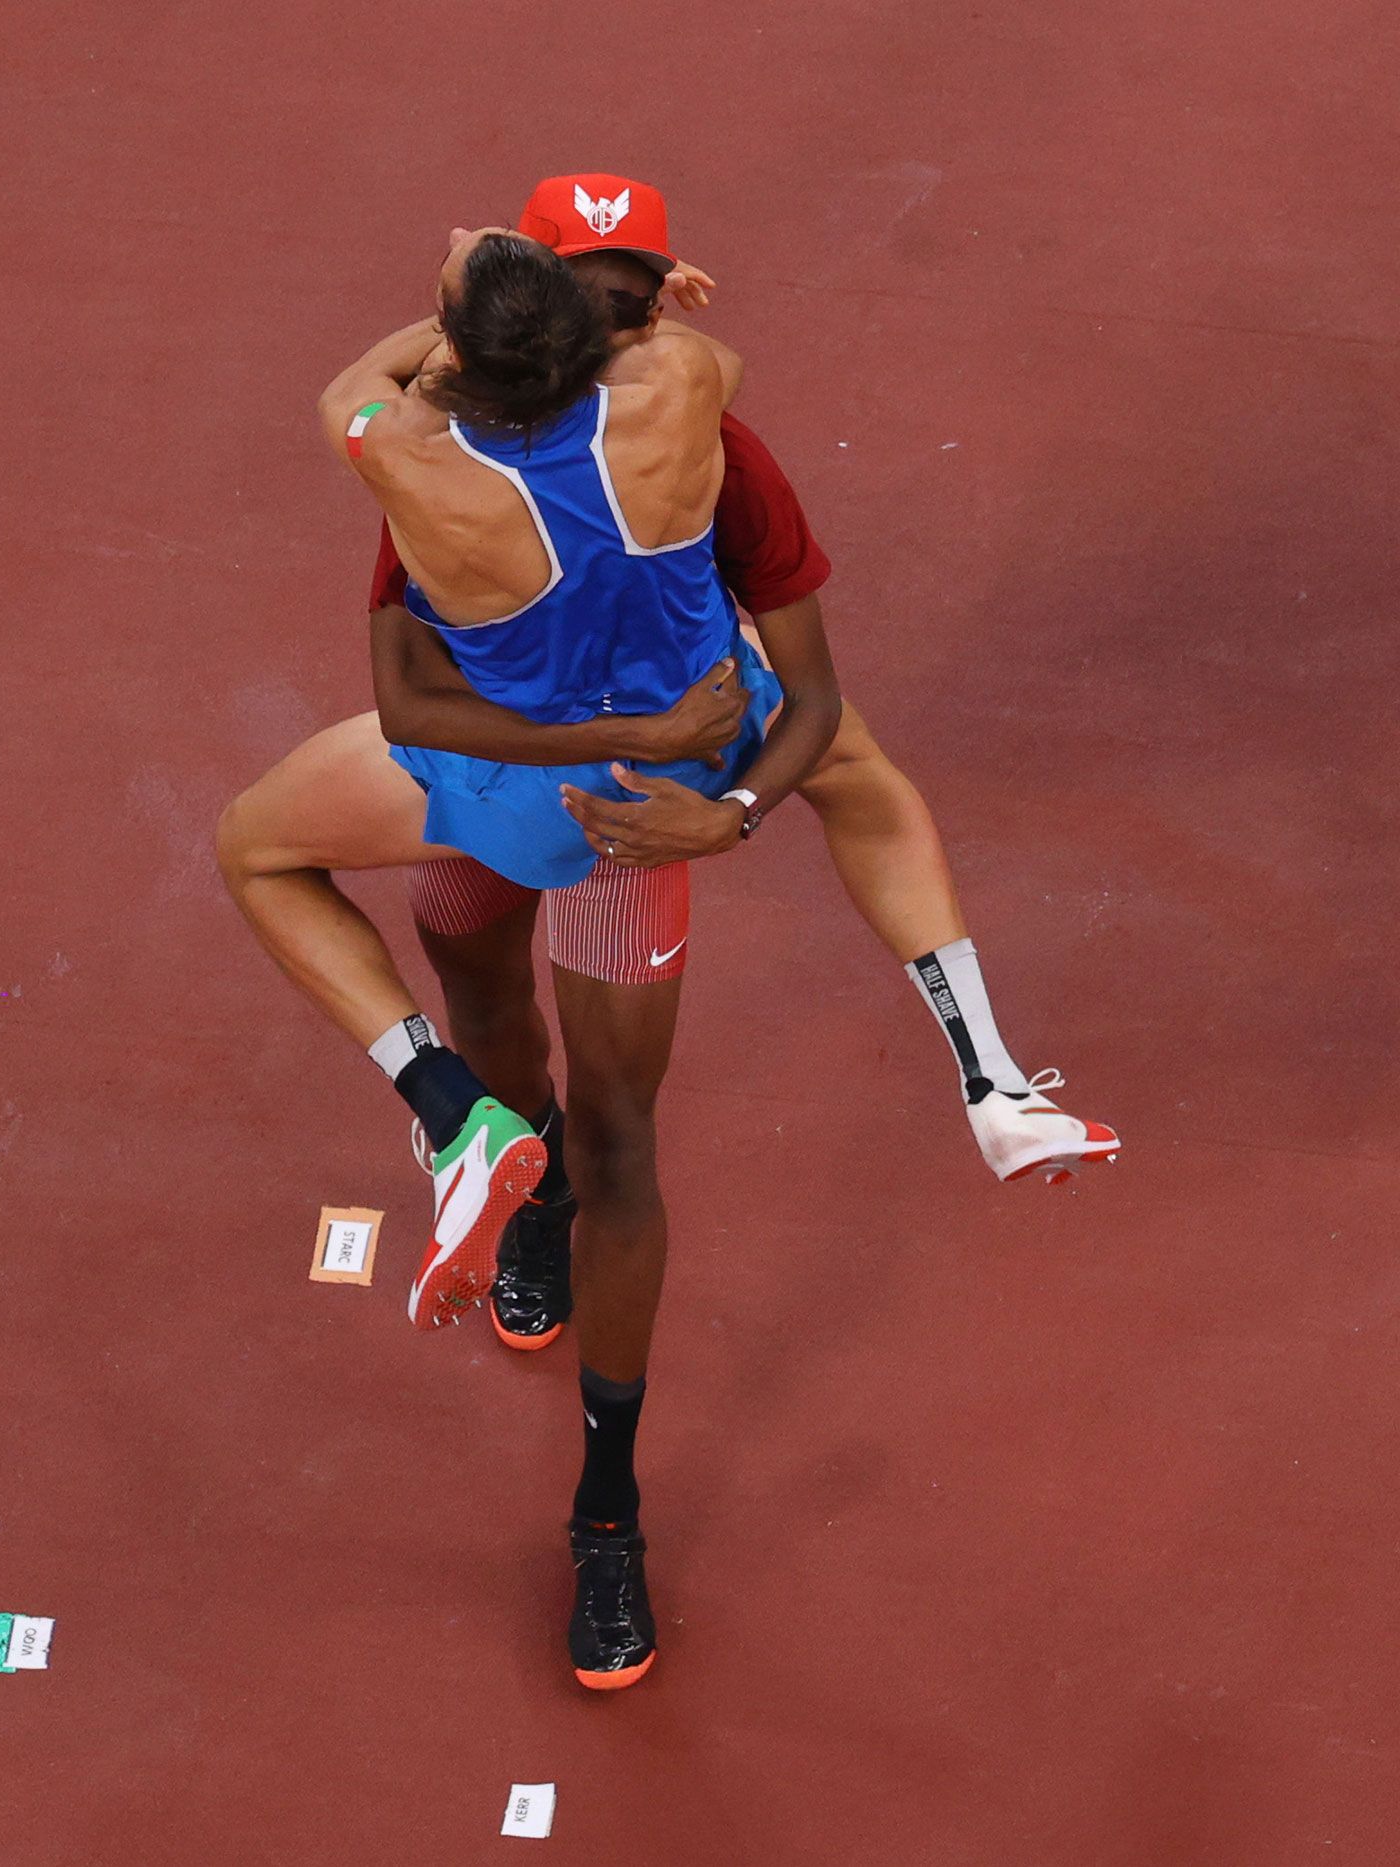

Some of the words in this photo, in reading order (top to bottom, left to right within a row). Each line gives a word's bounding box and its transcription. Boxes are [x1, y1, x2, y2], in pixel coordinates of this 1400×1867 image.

[920, 964, 945, 988] HALF
[932, 989, 959, 1022] SHAVE
[338, 1231, 355, 1264] STARC
[514, 1797, 530, 1823] KERR
